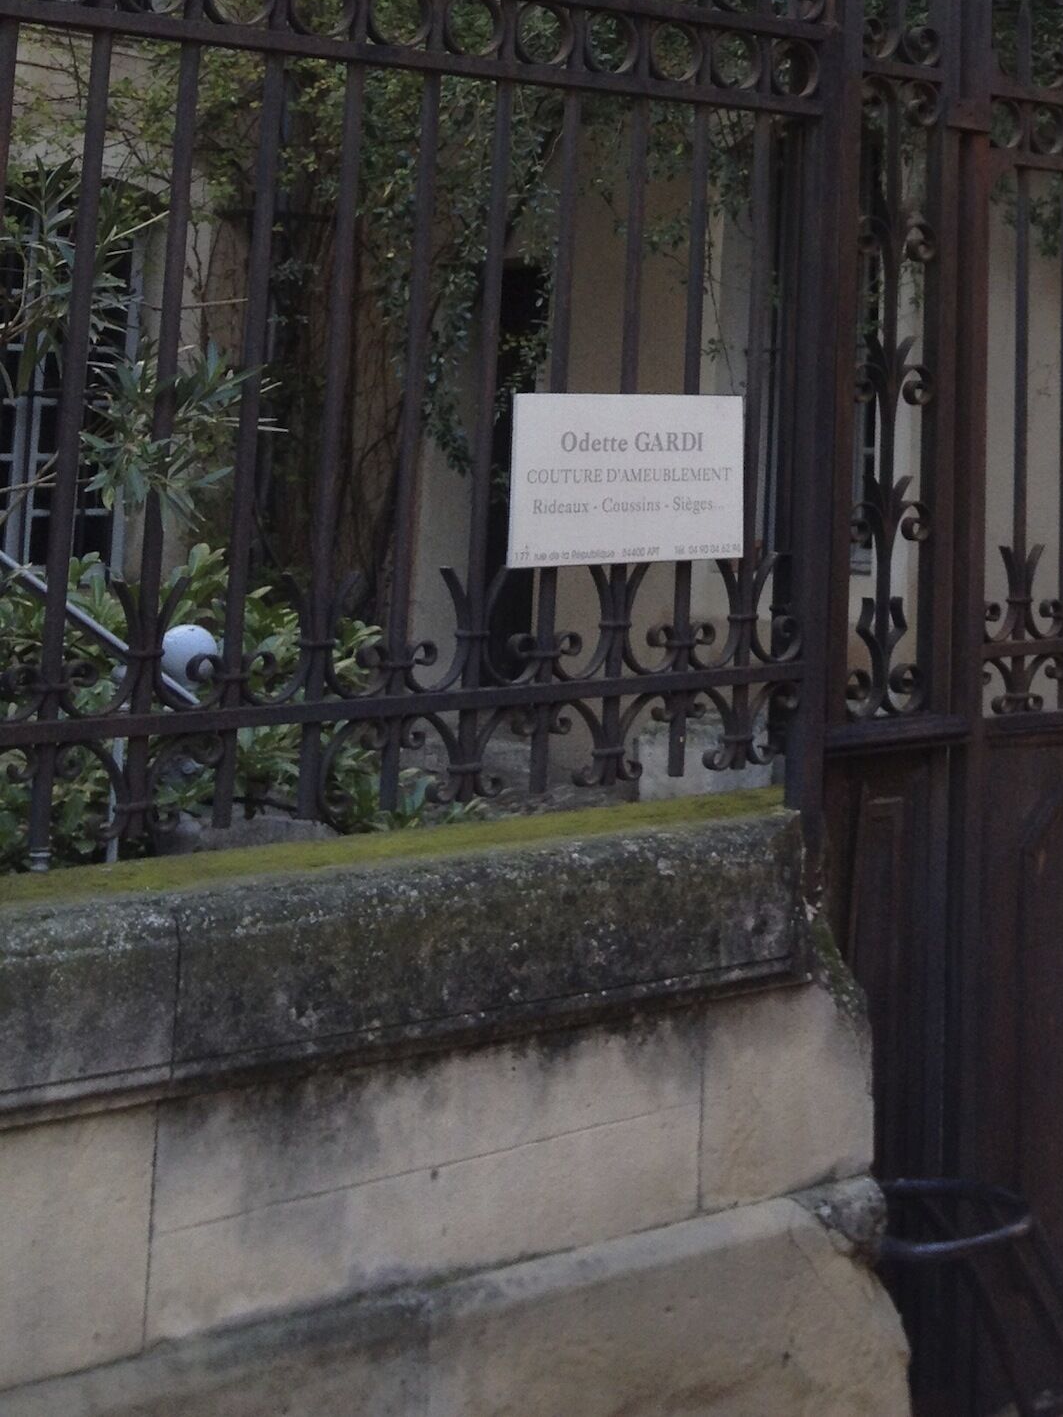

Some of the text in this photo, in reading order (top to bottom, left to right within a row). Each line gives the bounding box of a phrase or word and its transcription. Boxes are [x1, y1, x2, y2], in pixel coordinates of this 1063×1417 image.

[561, 431, 704, 453] Odette GARDI
[526, 467, 732, 484] COUTURE D'AMEUBLEMENT
[532, 499, 590, 515] Rideaux
[601, 497, 661, 514] Coussins
